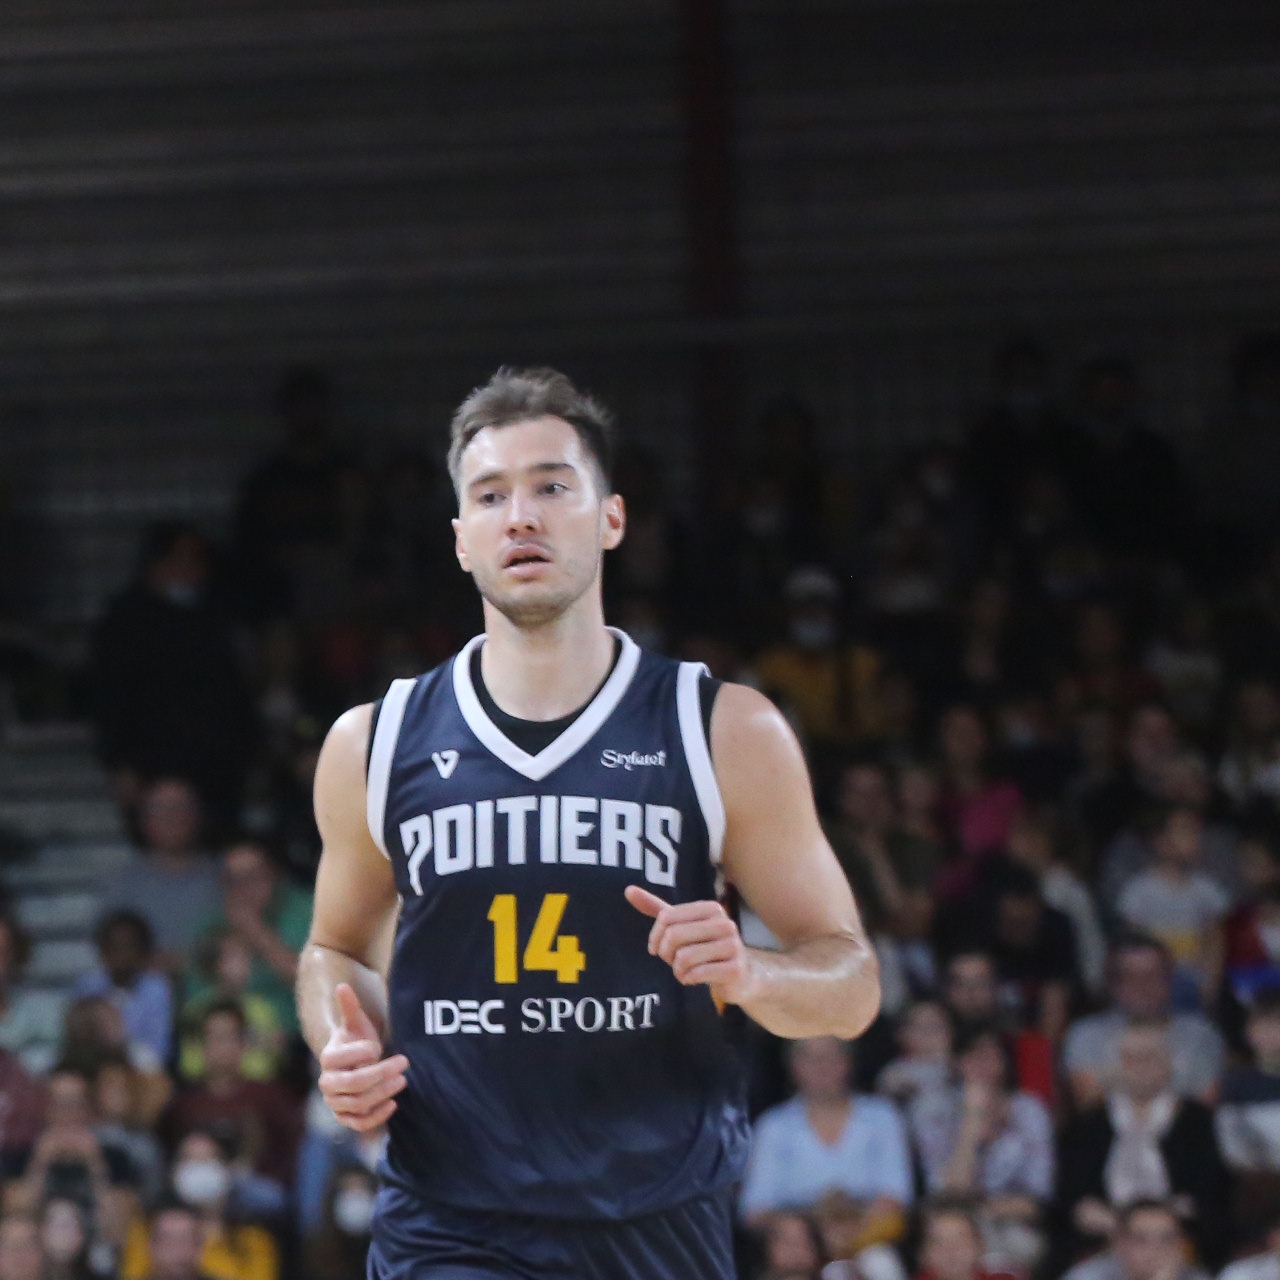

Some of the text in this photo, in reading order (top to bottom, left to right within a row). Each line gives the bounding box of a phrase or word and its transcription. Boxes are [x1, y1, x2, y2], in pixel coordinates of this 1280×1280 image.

[399, 795, 682, 896] POITIERS
[487, 893, 586, 984] 14
[424, 993, 661, 1035] IDEC SPORT
